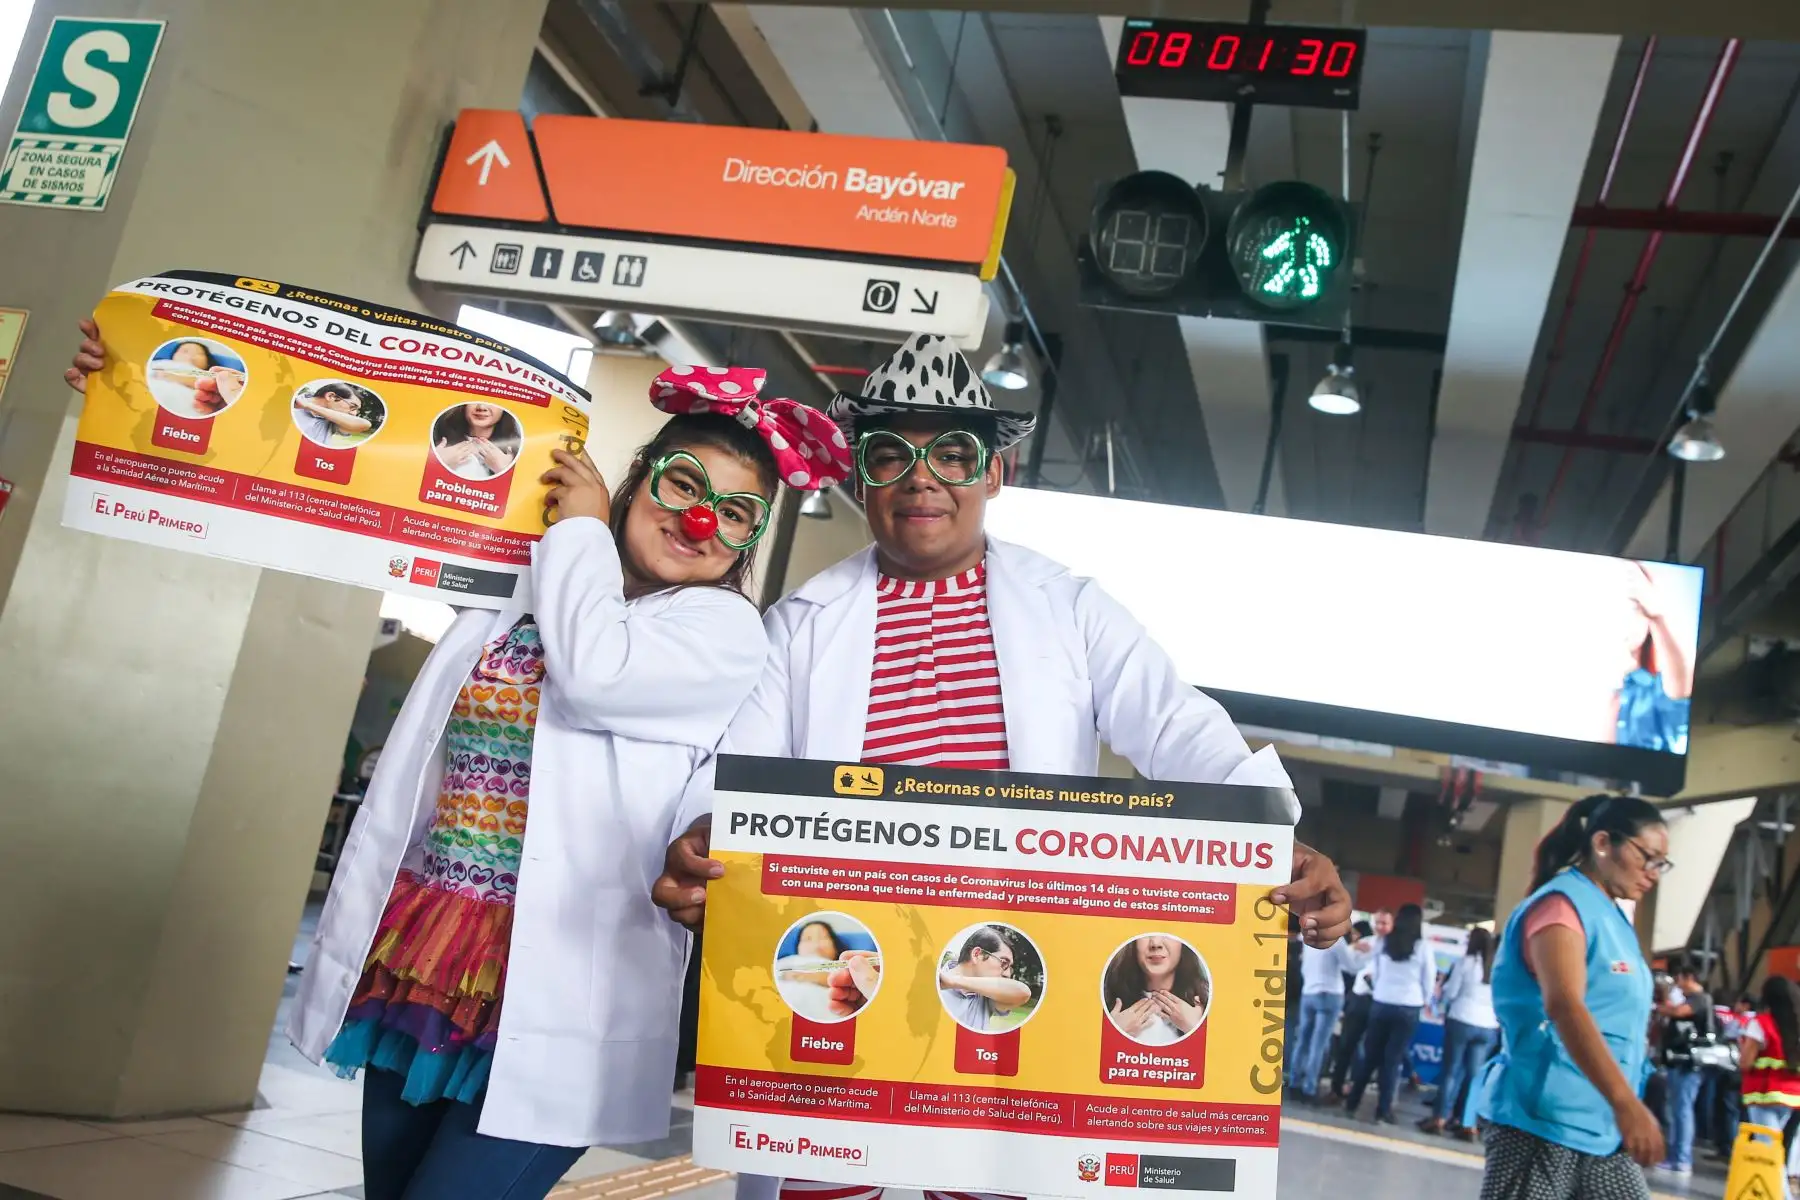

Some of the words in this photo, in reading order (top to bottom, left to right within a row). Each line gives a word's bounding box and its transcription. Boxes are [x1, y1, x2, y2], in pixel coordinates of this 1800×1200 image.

[1127, 31, 1192, 68] 08
[1207, 35, 1274, 72] 01
[1290, 39, 1357, 77] 30
[47, 30, 130, 128] S
[21, 152, 53, 164] ZONA
[56, 153, 102, 166] SEGURA
[29, 166, 44, 177] EN
[48, 167, 86, 179] CASOS
[723, 157, 838, 190] Dirección
[845, 167, 965, 200] Bayóvar
[22, 178, 37, 189] DE
[41, 179, 84, 192] SISMOS
[856, 205, 908, 224] Andén
[912, 210, 957, 228] Norte
[286, 291, 358, 312] ¿Retornas
[374, 312, 417, 326] visitas
[421, 322, 472, 339] nuestro
[475, 337, 511, 353] país?
[136, 281, 319, 329] PROTÉGENOS
[325, 321, 372, 347] DEL
[380, 336, 578, 403] CORONAVIRUS
[162, 426, 200, 443] Fiebre
[94, 451, 105, 460] En
[114, 457, 159, 471] aeropuerto
[168, 468, 197, 478] puerto
[198, 474, 225, 484] acude
[315, 458, 335, 471] Tos
[102, 463, 109, 472] la
[111, 465, 144, 479] Sanidad
[144, 473, 169, 484] Aérea
[178, 479, 217, 494] Marítima.
[251, 483, 277, 495] Llama
[278, 489, 287, 497] al
[289, 491, 305, 500] 113
[307, 495, 338, 508] (central
[340, 503, 380, 517] telefónica
[435, 478, 496, 501] Problemas
[245, 493, 259, 502] del
[260, 496, 303, 511] Ministerio
[304, 505, 317, 514] de
[318, 507, 343, 519] Salud
[343, 513, 358, 523] del
[358, 516, 382, 528] Perú).
[426, 489, 452, 503] para
[455, 493, 500, 512] respirar
[402, 526, 442, 541] alertando
[443, 536, 467, 546] sobre
[467, 539, 482, 549] sus
[483, 544, 505, 554] viajes
[403, 515, 430, 528] Acude
[431, 522, 440, 530] al
[440, 525, 467, 536] centro
[469, 529, 480, 538] de
[482, 532, 503, 544] salud
[415, 565, 437, 578] PERÚ
[443, 573, 474, 584] Ministerio
[451, 580, 468, 589] Salud
[894, 778, 980, 796] ¿Retornas
[985, 786, 995, 797] o
[1000, 784, 1054, 800] visitas
[1059, 791, 1124, 805] nuestro
[1128, 792, 1174, 809] país?
[730, 811, 940, 848] PROTÉGENOS
[950, 825, 1007, 852] DEL
[1015, 828, 1273, 869] CORONAVIRUS
[769, 863, 779, 872] Si
[781, 865, 829, 876] estuviste
[832, 869, 845, 877] en
[848, 870, 862, 878] un
[864, 870, 887, 881] país
[889, 873, 909, 881] con
[911, 874, 941, 883] casos
[944, 874, 958, 884] de
[960, 875, 1025, 888] Coronavirus
[1028, 879, 1044, 889] los
[1046, 880, 1087, 892] últimos
[1090, 884, 1104, 893] 14
[1107, 884, 1129, 895] días
[1132, 888, 1139, 896] o
[1142, 888, 1179, 898] tuviste
[1182, 891, 1229, 901] contacto
[782, 879, 801, 887] con
[804, 881, 823, 889] una
[826, 882, 870, 892] persona
[872, 885, 893, 895] que
[896, 884, 923, 895] tiene
[926, 886, 936, 896] la
[938, 888, 1005, 901] enfermedad
[1008, 894, 1015, 903] y
[1017, 894, 1070, 905] presentas
[1072, 896, 1111, 908] alguno
[1113, 898, 1127, 908] de
[1130, 901, 1159, 911] estos
[1161, 902, 1214, 914] síntomas:
[1250, 896, 1289, 1094] Covid-19
[801, 1037, 844, 1051] Fiebre
[976, 1049, 998, 1061] Tos
[1116, 1052, 1189, 1068] Problemas
[1108, 1067, 1139, 1081] para
[1143, 1069, 1196, 1083] respirar
[725, 1075, 737, 1084] En
[739, 1077, 748, 1085] el
[750, 1080, 803, 1091] aeropuerto
[814, 1086, 846, 1094] puerto
[848, 1087, 878, 1097] acude
[737, 1089, 745, 1098] la
[748, 1090, 786, 1102] Sanidad
[788, 1094, 816, 1105] Aérea
[828, 1097, 872, 1109] Marítima.
[910, 1090, 938, 1101] Llama
[941, 1092, 950, 1102] al
[953, 1094, 970, 1103] 113
[973, 1094, 1008, 1106] (central
[1011, 1098, 1059, 1110] telefónica
[904, 1103, 920, 1113] del
[922, 1104, 970, 1116] Ministerio
[972, 1106, 985, 1117] de
[988, 1107, 1015, 1119] Salud
[1017, 1111, 1033, 1121] del
[1035, 1112, 1062, 1124] Perú).
[1086, 1103, 1118, 1114] Acude
[1121, 1106, 1129, 1115] al
[1132, 1108, 1163, 1117] centro
[1165, 1108, 1178, 1117] de
[1181, 1109, 1207, 1119] salud
[1209, 1111, 1229, 1120] más
[1231, 1113, 1269, 1121] cercano
[1087, 1116, 1134, 1128] alertando
[1136, 1120, 1164, 1130] sobre
[1185, 1122, 1212, 1134] viajes
[1214, 1126, 1220, 1135] y
[1222, 1124, 1266, 1135] síntomas.
[1109, 1164, 1135, 1176] PERÚ
[1143, 1175, 1152, 1184] de
[1154, 1176, 1175, 1186] Salud
[1144, 1167, 1181, 1177] Ministerio
